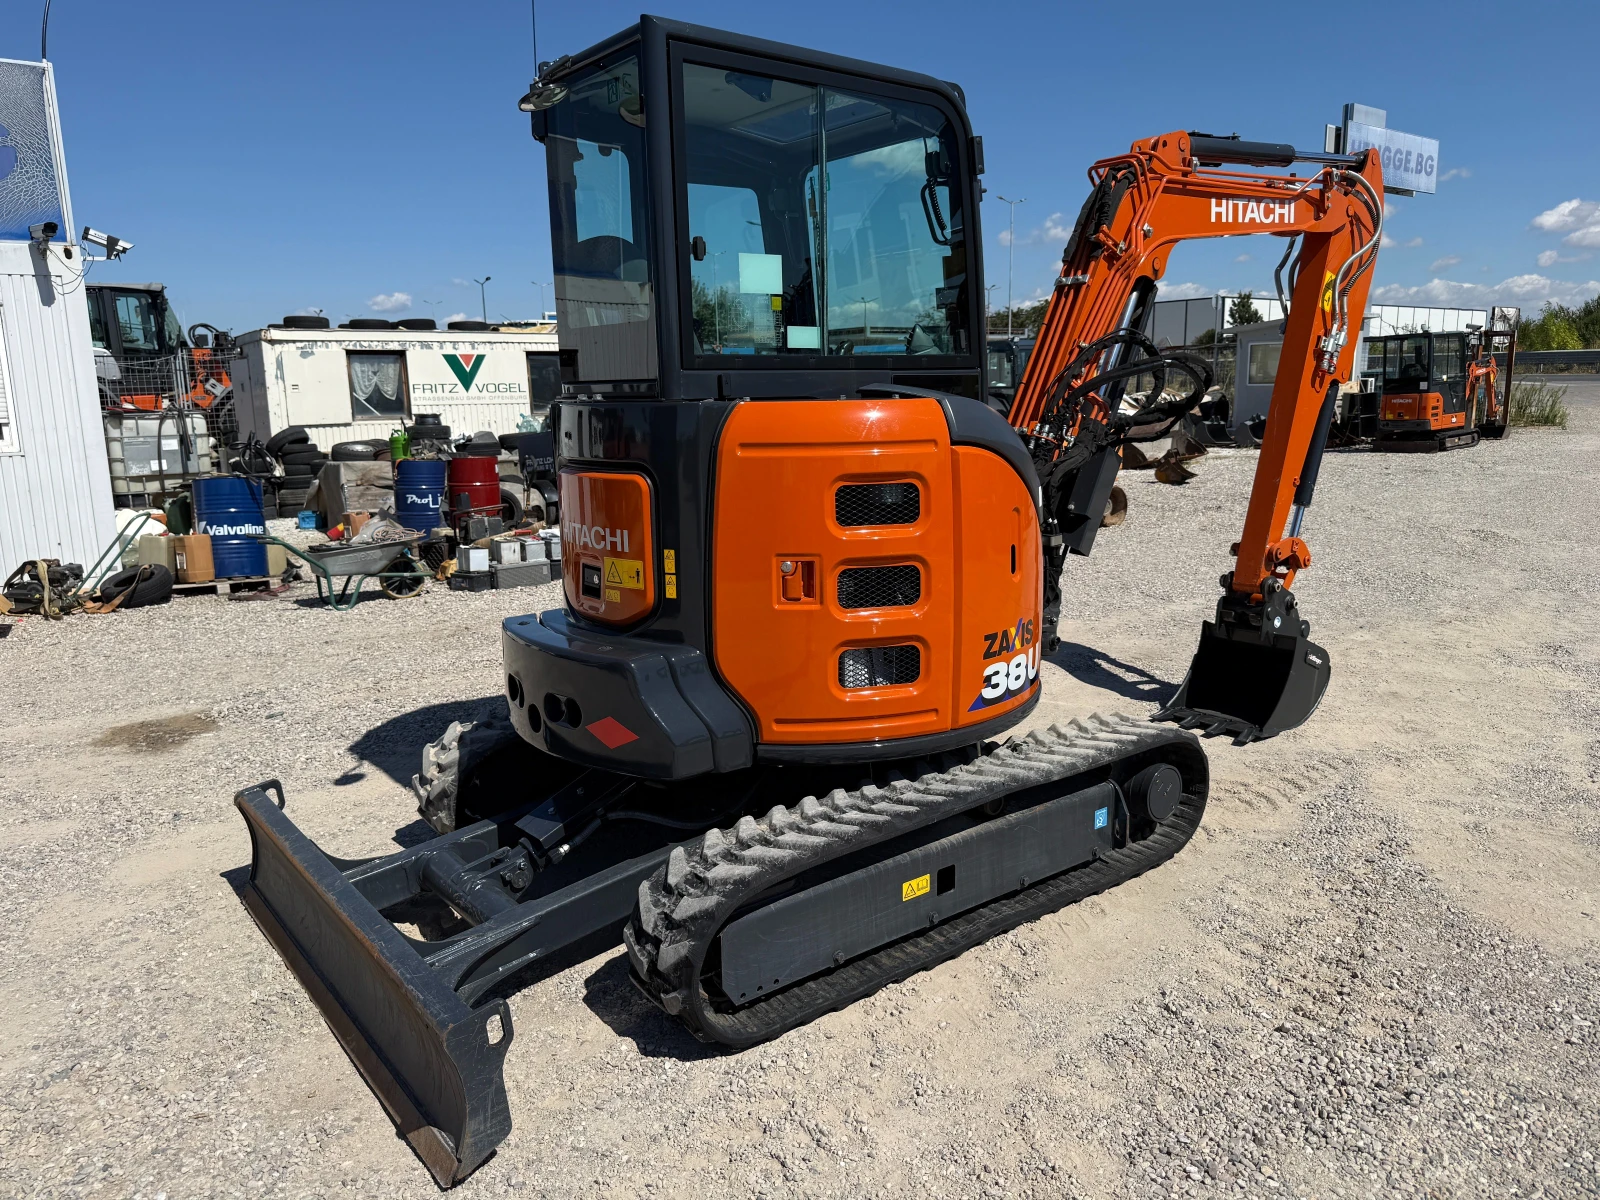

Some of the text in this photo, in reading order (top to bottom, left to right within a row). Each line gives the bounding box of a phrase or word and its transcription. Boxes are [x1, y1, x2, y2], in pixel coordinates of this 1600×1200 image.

[1210, 197, 1296, 224] HITACHI
[412, 382, 527, 394] FRITZ VOGEL
[206, 523, 264, 536] Valvoline
[562, 520, 629, 553] HITACHI
[983, 617, 1034, 660] ZAXIS
[981, 640, 1039, 700] 38U
